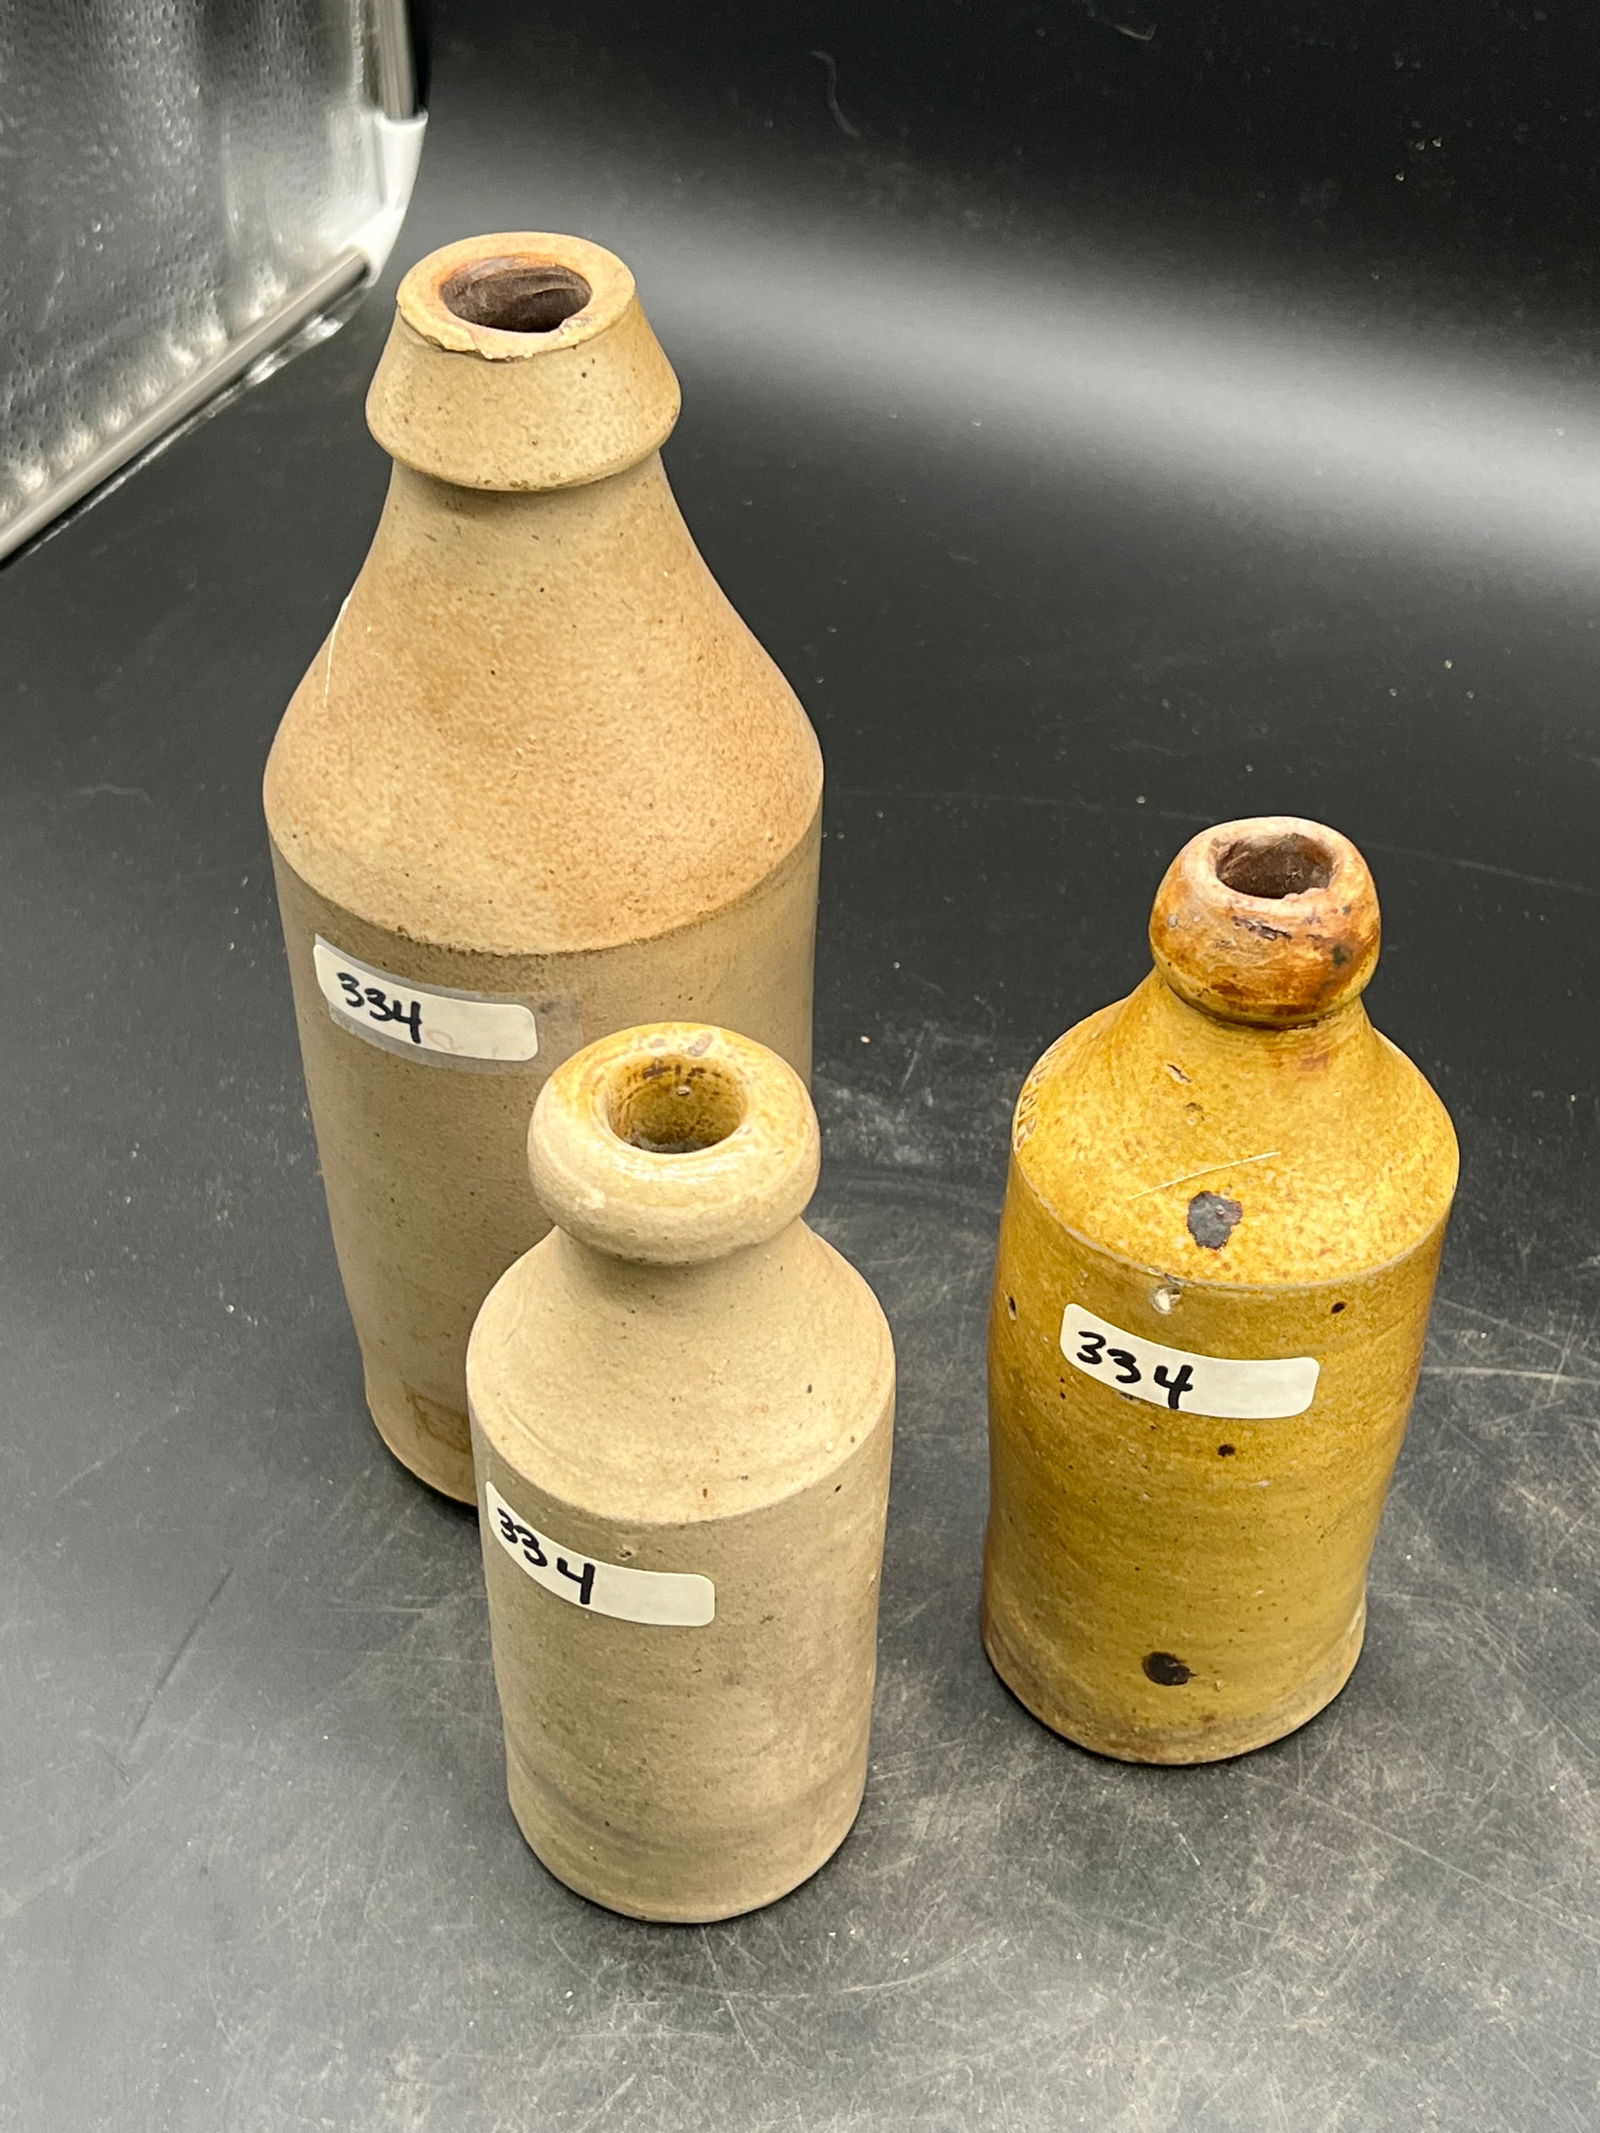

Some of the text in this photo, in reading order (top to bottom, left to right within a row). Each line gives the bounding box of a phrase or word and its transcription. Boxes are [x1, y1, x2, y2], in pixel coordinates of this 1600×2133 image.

[337, 972, 422, 1044] 334
[1076, 1331, 1194, 1411] 334
[497, 1508, 596, 1605] 334
